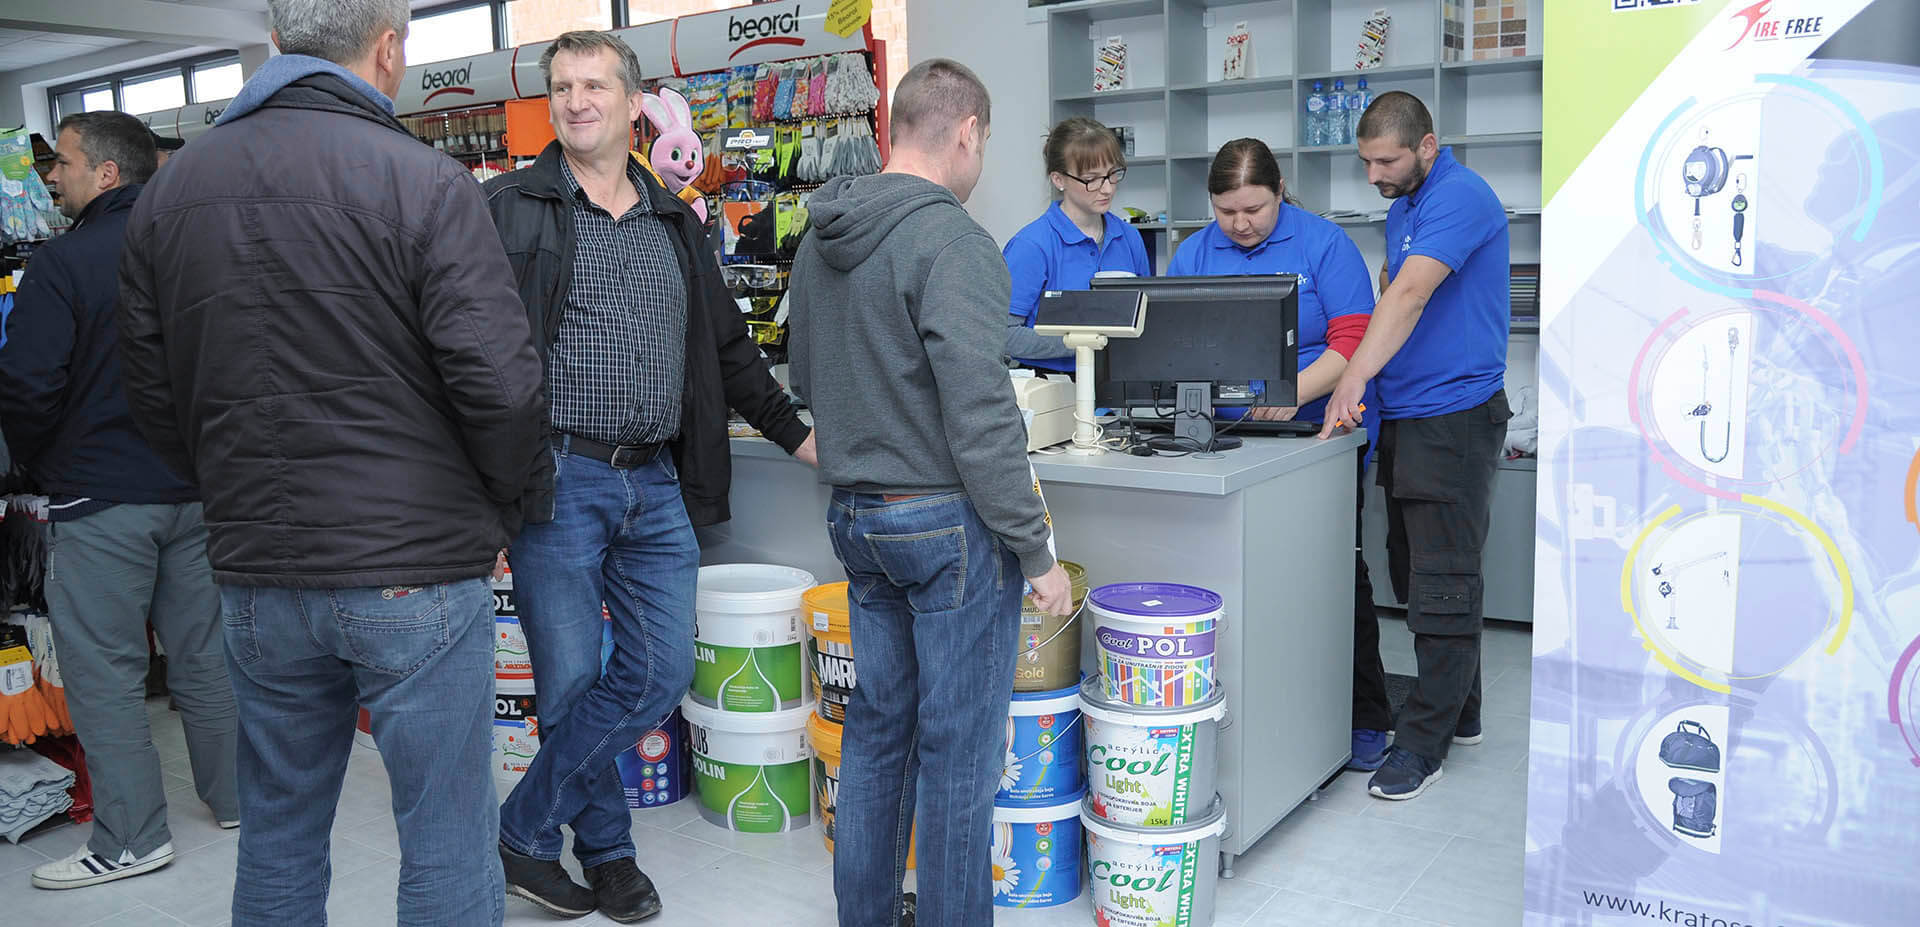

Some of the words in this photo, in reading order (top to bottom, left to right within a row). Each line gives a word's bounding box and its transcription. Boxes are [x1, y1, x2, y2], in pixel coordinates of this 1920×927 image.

[728, 4, 801, 42] beorol
[1784, 16, 1823, 35] FREE
[422, 61, 472, 90] beorol
[1101, 632, 1133, 650] Cool
[1136, 636, 1194, 657] POL
[1089, 744, 1171, 776] Cool
[1178, 724, 1193, 775] EXTRA
[1105, 773, 1142, 794] Light
[1173, 777, 1189, 826] WHITE
[1151, 818, 1168, 827] 15kg
[1093, 860, 1175, 892] Cool
[1182, 841, 1197, 890] EXTRA
[1109, 889, 1146, 909] Light
